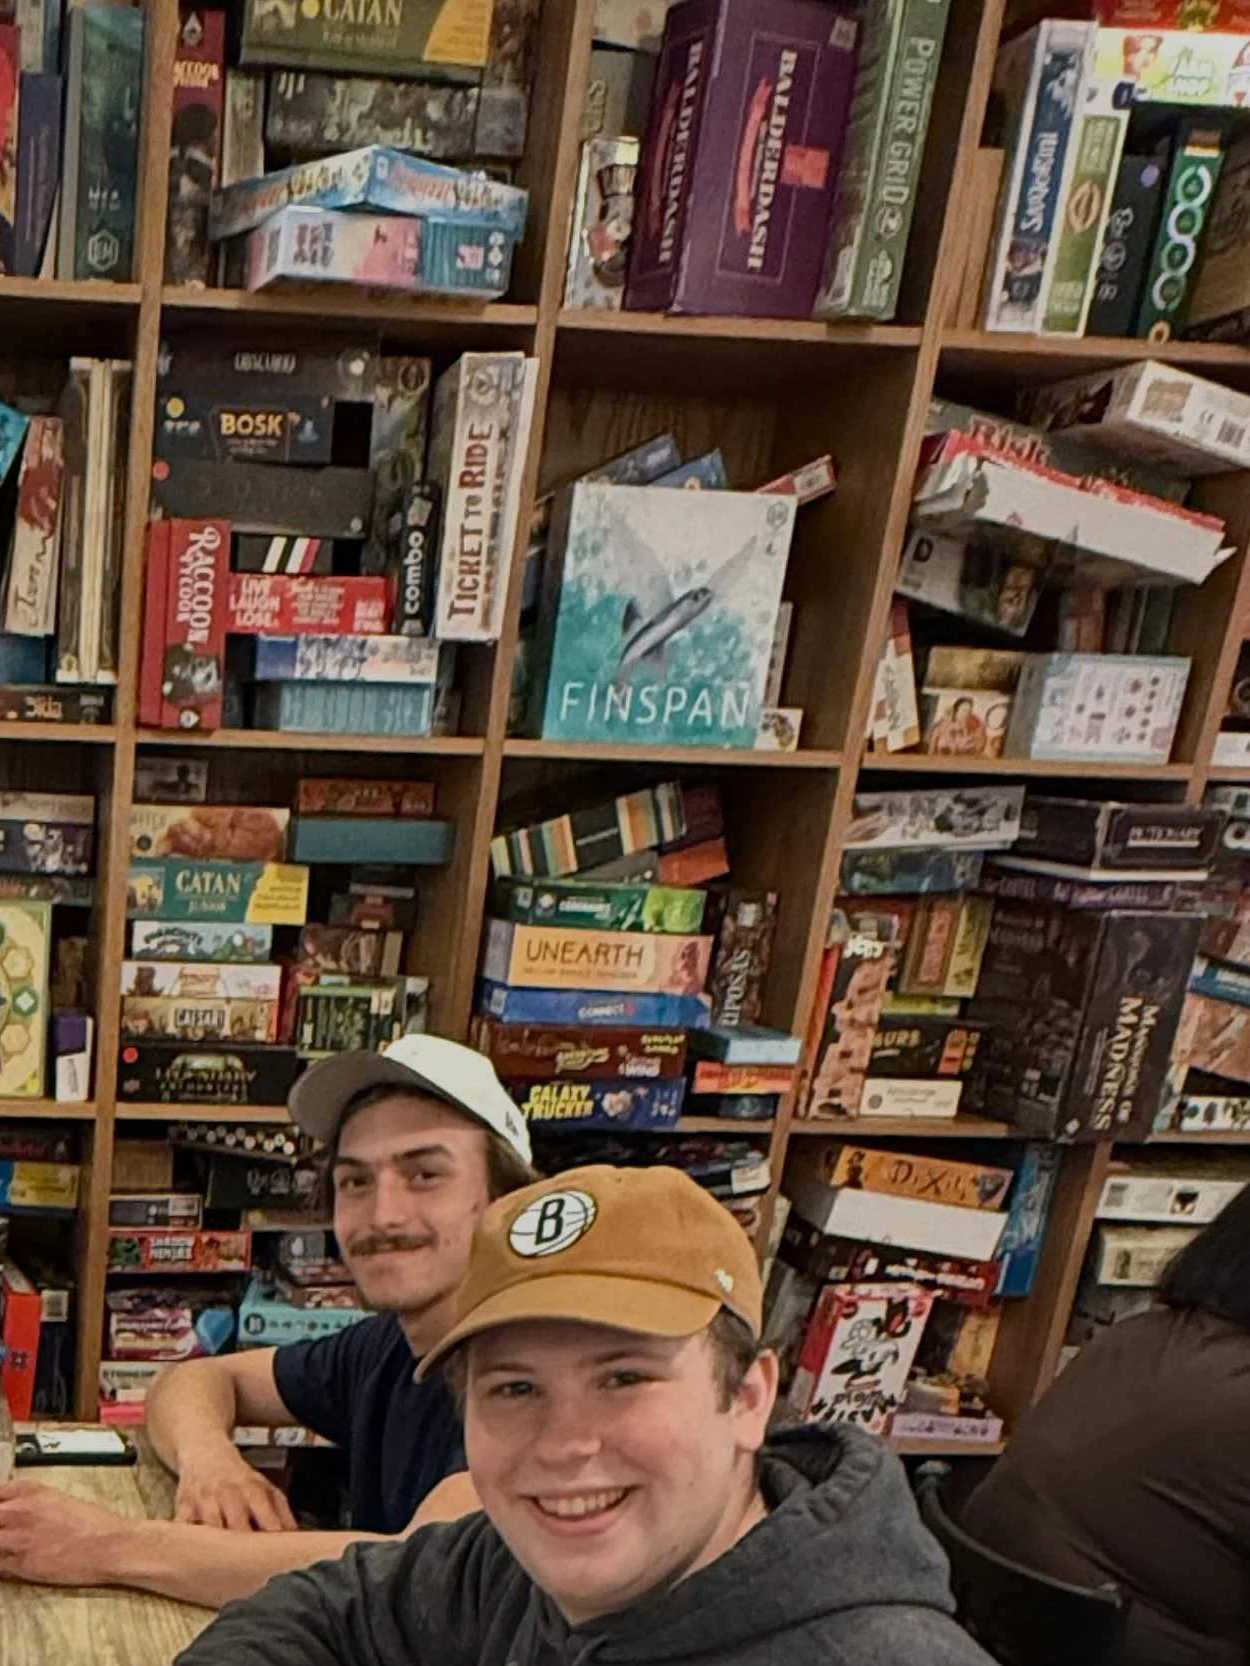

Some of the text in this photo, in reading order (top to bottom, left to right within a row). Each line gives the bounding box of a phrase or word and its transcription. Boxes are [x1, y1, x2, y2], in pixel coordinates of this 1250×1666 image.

[656, 40, 704, 266] BALDERDASH
[882, 36, 935, 206] POWER GRID
[746, 48, 799, 270] BALDERDASH
[220, 412, 283, 436] BOSK
[458, 421, 494, 490] RIDE
[188, 525, 223, 645] RACCOON
[403, 531, 424, 616] combo
[448, 524, 484, 621] TICKET
[558, 680, 748, 729] FINSPAN
[175, 869, 242, 895] CATAN
[525, 938, 645, 967] UNEARTH
[528, 1084, 593, 1103] GALAXY
[1093, 996, 1145, 1131] MADNESS
[522, 1099, 595, 1120] TRUCKER
[534, 1198, 565, 1246] B
